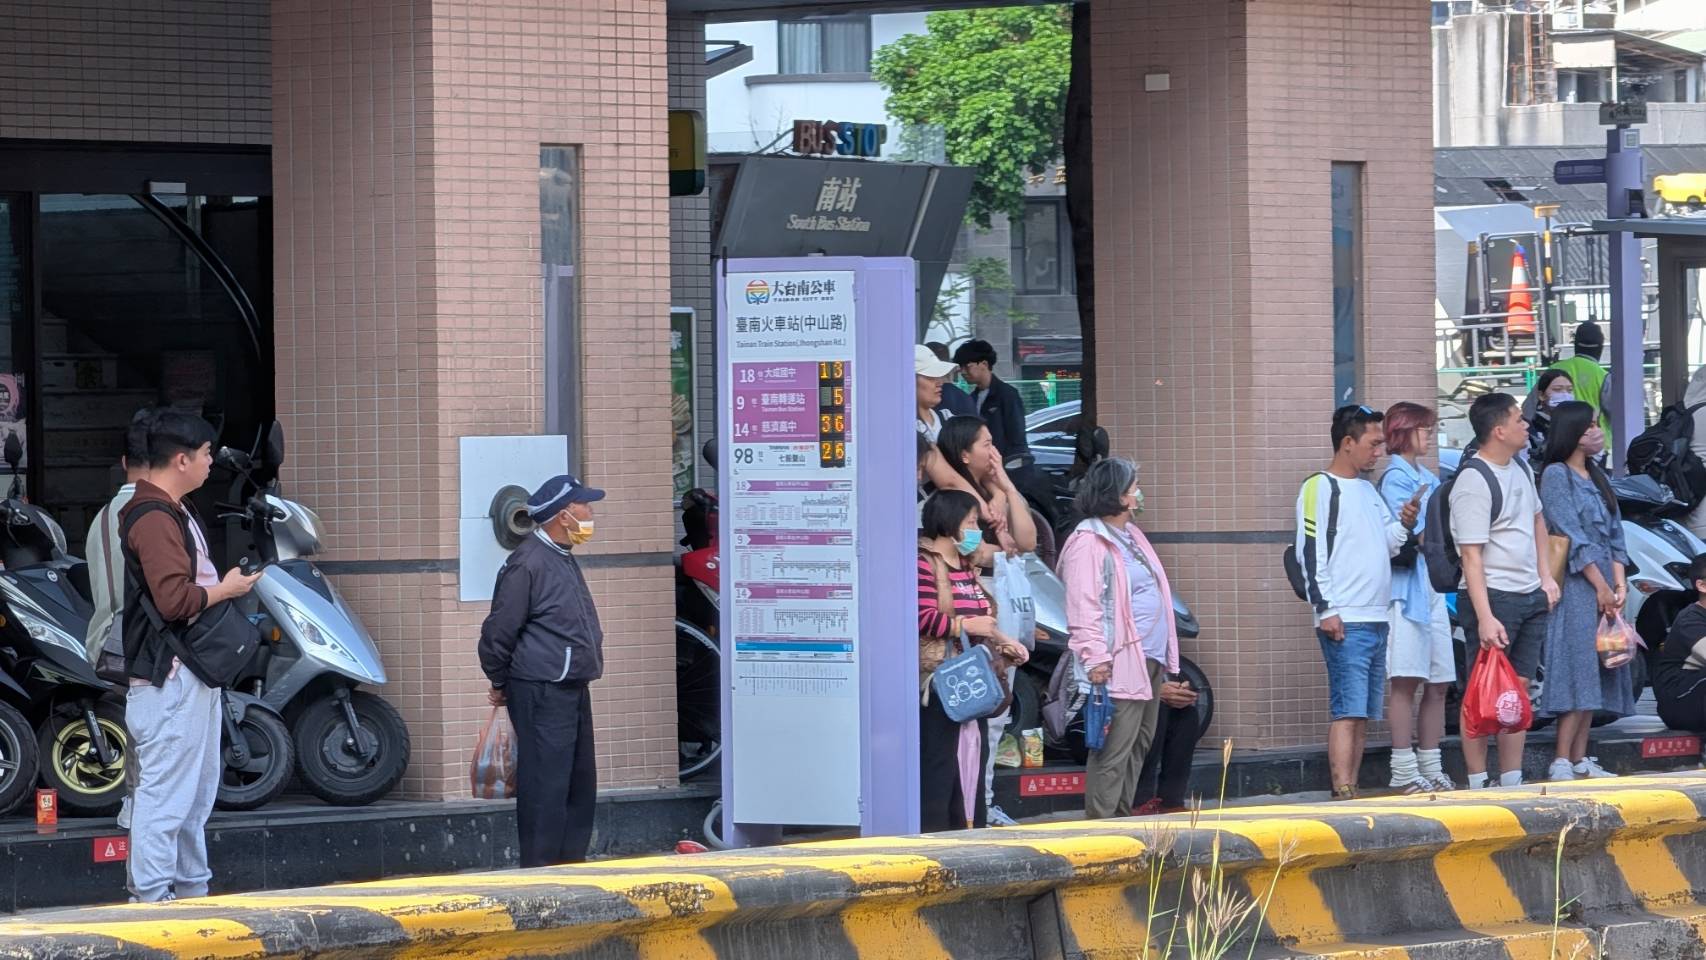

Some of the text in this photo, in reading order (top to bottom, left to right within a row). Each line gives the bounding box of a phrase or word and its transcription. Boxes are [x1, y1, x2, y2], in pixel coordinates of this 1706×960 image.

[796, 120, 837, 155] BUS
[815, 177, 862, 213] 南站
[786, 214, 871, 232] South Bus Station
[772, 279, 836, 297] 大台南公車
[735, 314, 847, 333] 臺南火車站(中山路)
[736, 340, 757, 348] Tainan
[757, 340, 773, 348] Train
[739, 369, 756, 383] 18
[820, 361, 843, 379] 13
[736, 396, 745, 409] 9
[833, 387, 844, 406] 5
[734, 423, 749, 437] 14
[822, 415, 844, 432] 36
[734, 448, 754, 464] 98
[737, 535, 743, 545] 9
[735, 588, 747, 598] 14
